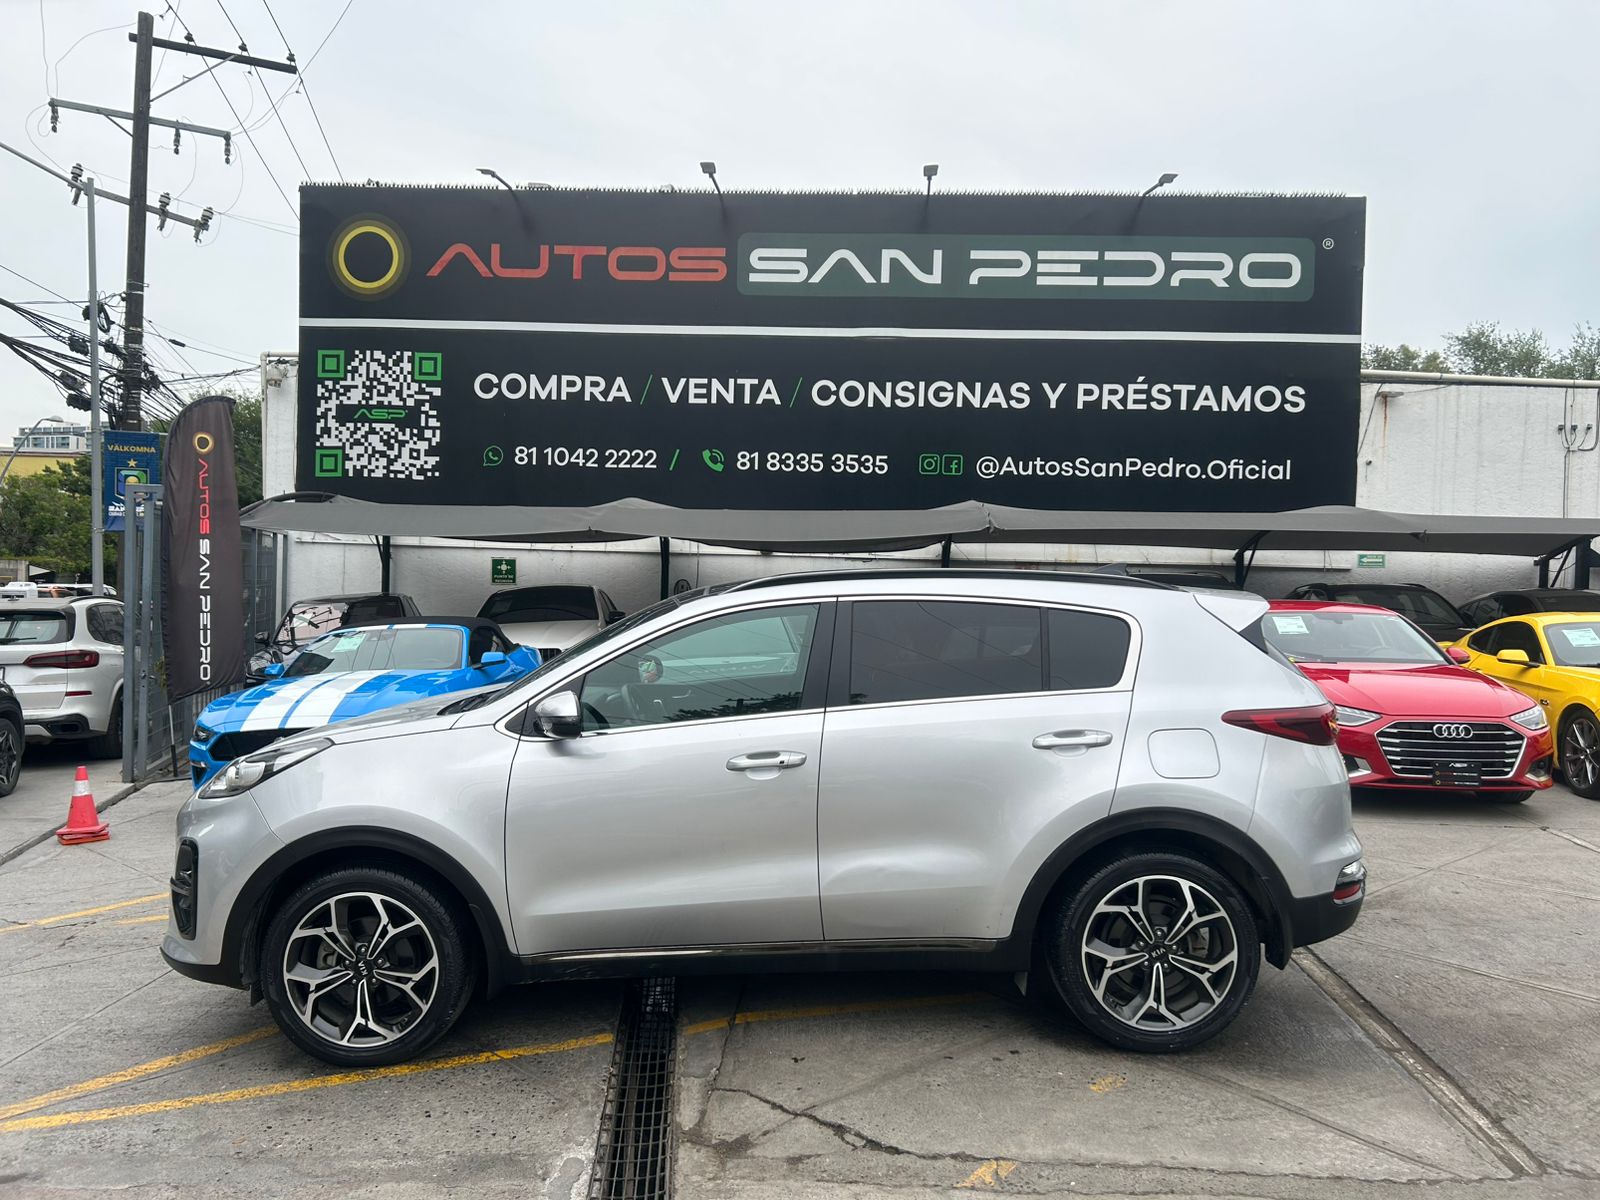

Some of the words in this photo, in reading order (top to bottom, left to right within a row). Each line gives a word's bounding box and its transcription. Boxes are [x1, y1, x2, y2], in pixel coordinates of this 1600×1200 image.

[426, 242, 728, 282] AUTOS
[748, 247, 943, 285] SAN
[968, 249, 1302, 288] PEDRO
[473, 372, 632, 403] COMPRA
[661, 377, 782, 405] VENTA
[811, 379, 1031, 409] CONSIGNAS
[1041, 382, 1067, 409] Y
[1076, 375, 1306, 413] PRÉSTAMOS
[353, 408, 406, 419] ASP
[514, 446, 538, 466] 81
[544, 447, 599, 468] 1042
[604, 449, 657, 469] 2222
[736, 451, 760, 471] 81
[766, 452, 824, 473] 8335
[831, 453, 889, 475] 3535
[975, 456, 1292, 481] @AutosSanPedro.Oficial
[198, 459, 211, 535] AUTOS
[199, 538, 211, 590] SAN
[199, 594, 211, 682] PEDRO
[1151, 947, 1166, 958] KIA
